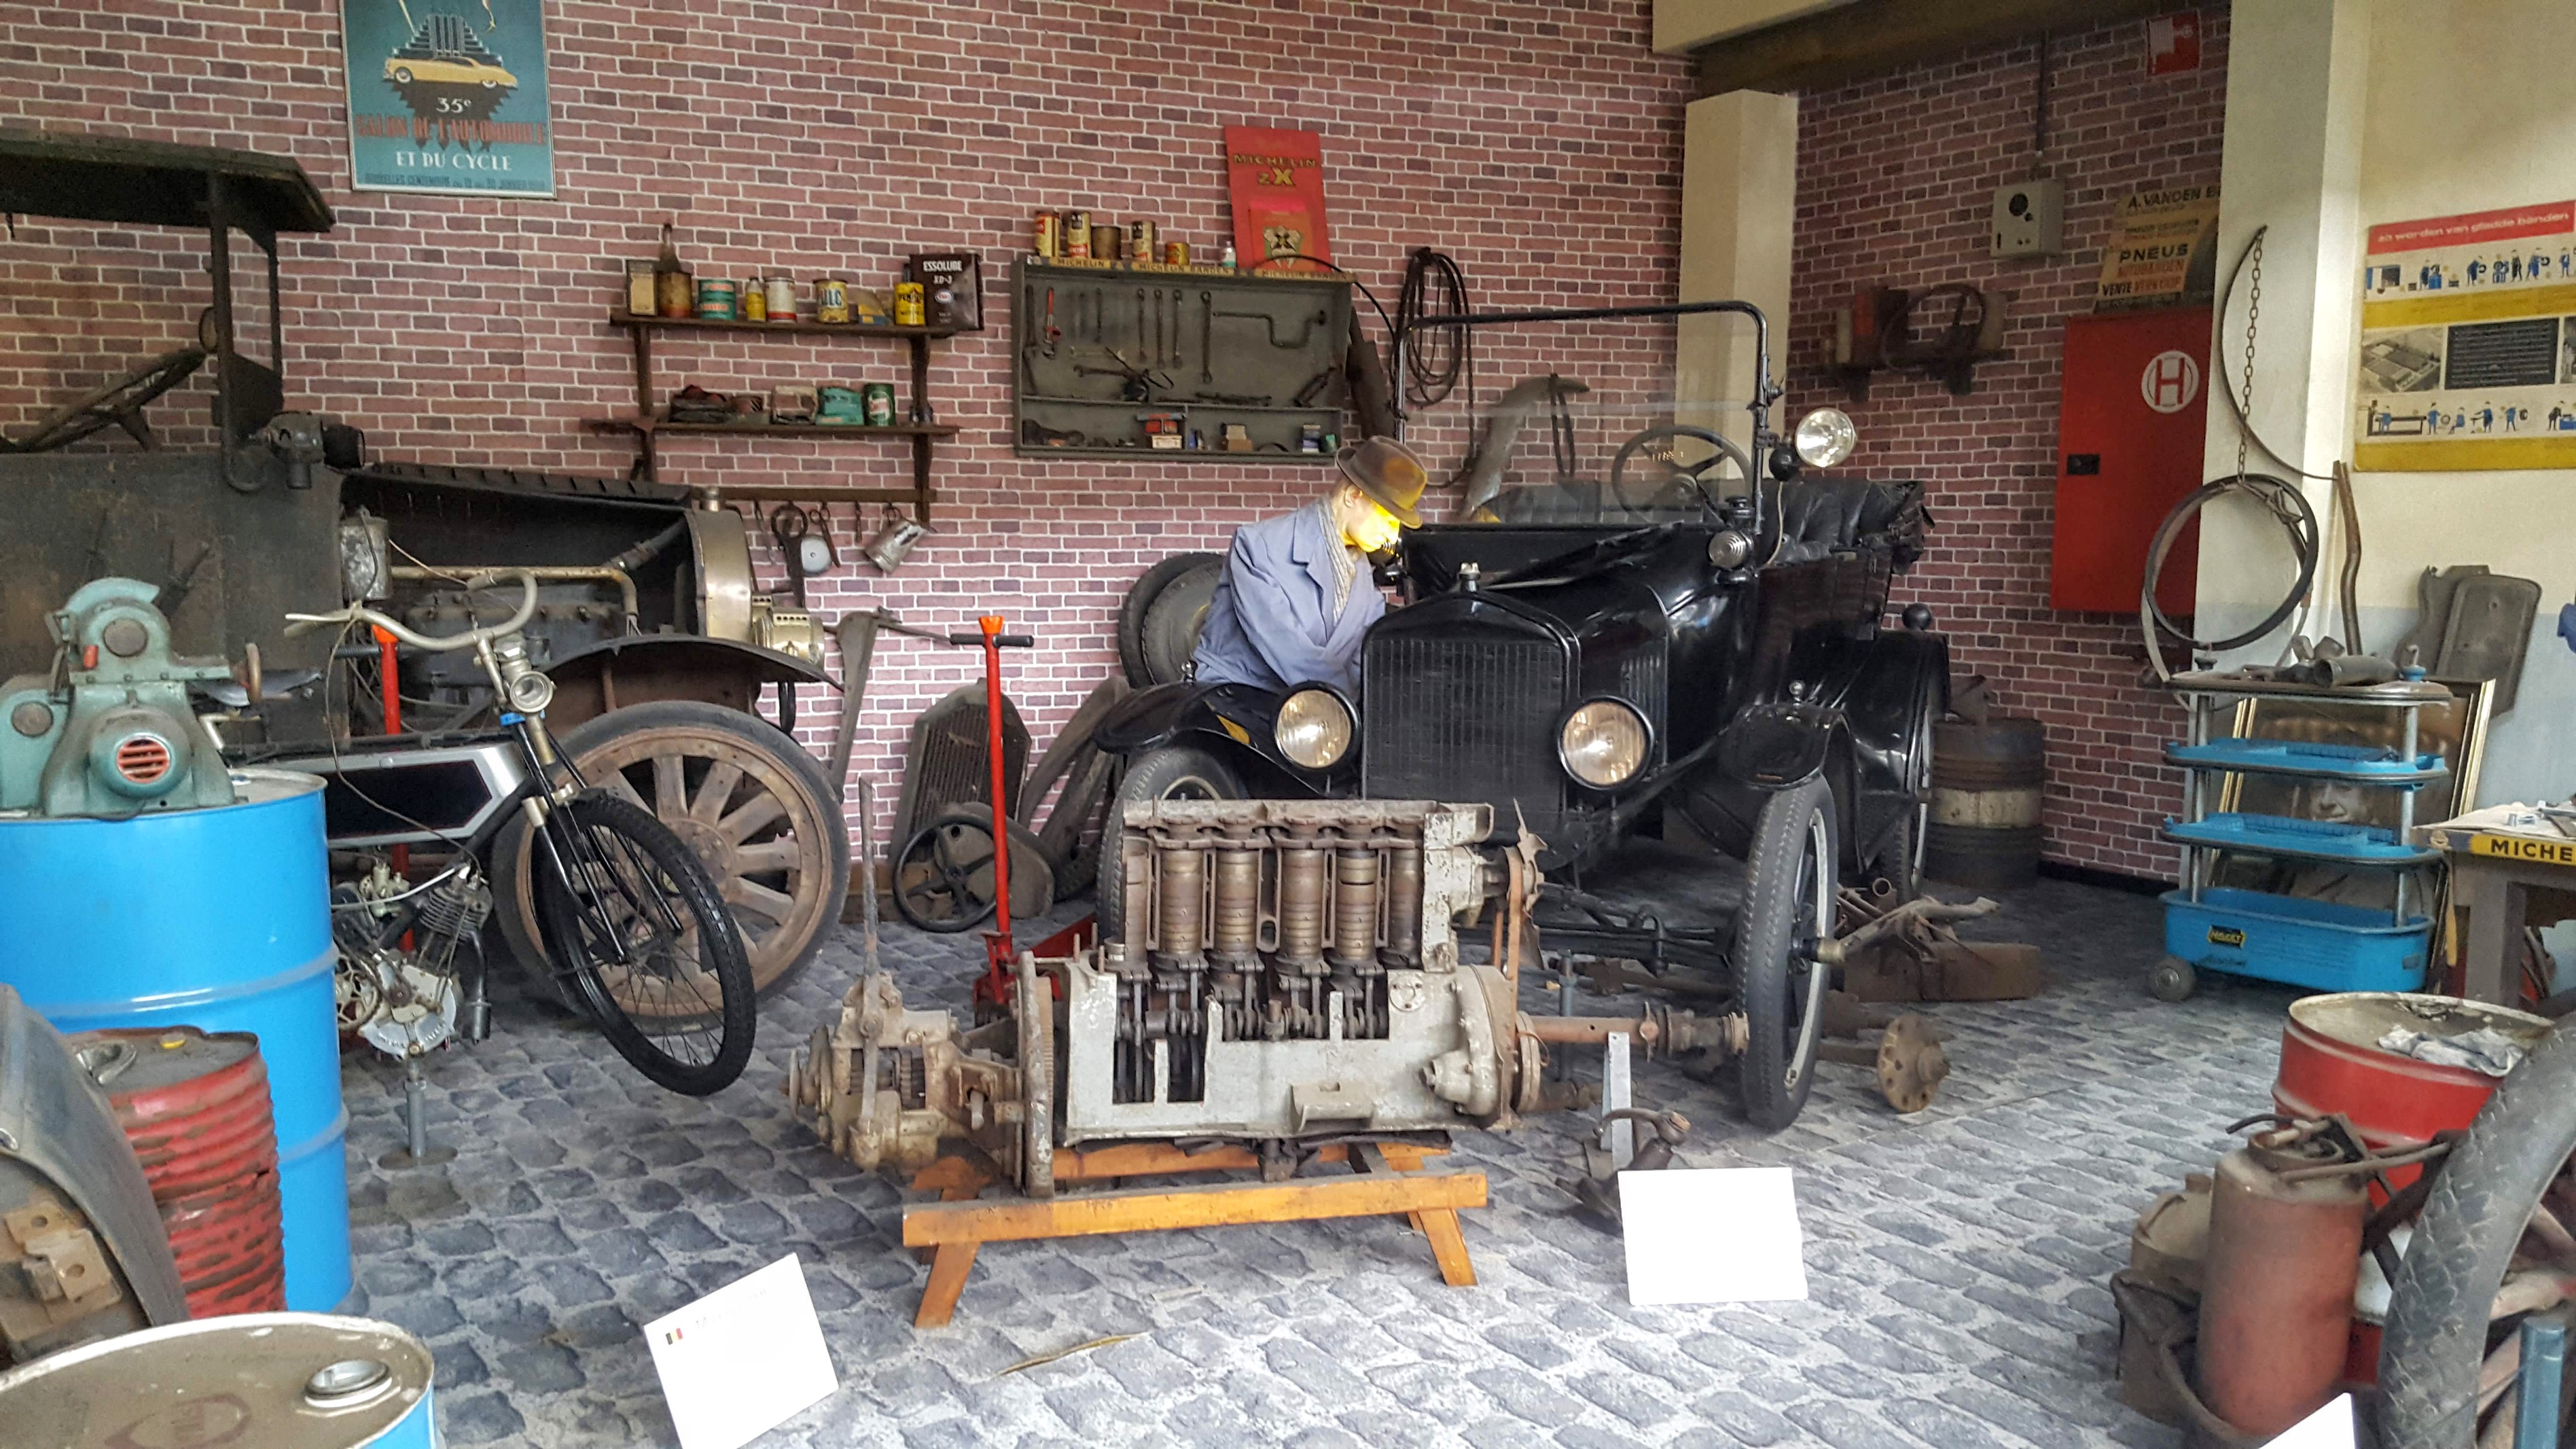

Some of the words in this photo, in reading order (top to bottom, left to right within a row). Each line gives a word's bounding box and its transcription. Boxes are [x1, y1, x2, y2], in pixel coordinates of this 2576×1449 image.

[355, 113, 408, 138] SALON
[396, 151, 416, 167] ET
[422, 152, 445, 168] DU
[452, 153, 513, 172] CYCLE
[1233, 154, 1316, 168] MICHELIN
[2143, 187, 2202, 206] VANDEN
[2395, 228, 2443, 242] worden
[2445, 225, 2470, 235] van
[2471, 218, 2515, 233] gladde
[2517, 212, 2570, 226] banden
[1058, 256, 1104, 268] MICHELIN
[2119, 243, 2189, 264] PNEUS
[923, 260, 962, 272] ESSOLUBE
[2102, 281, 2132, 297] VENTE
[2154, 357, 2185, 406] H
[2491, 838, 2573, 862] MICHE
